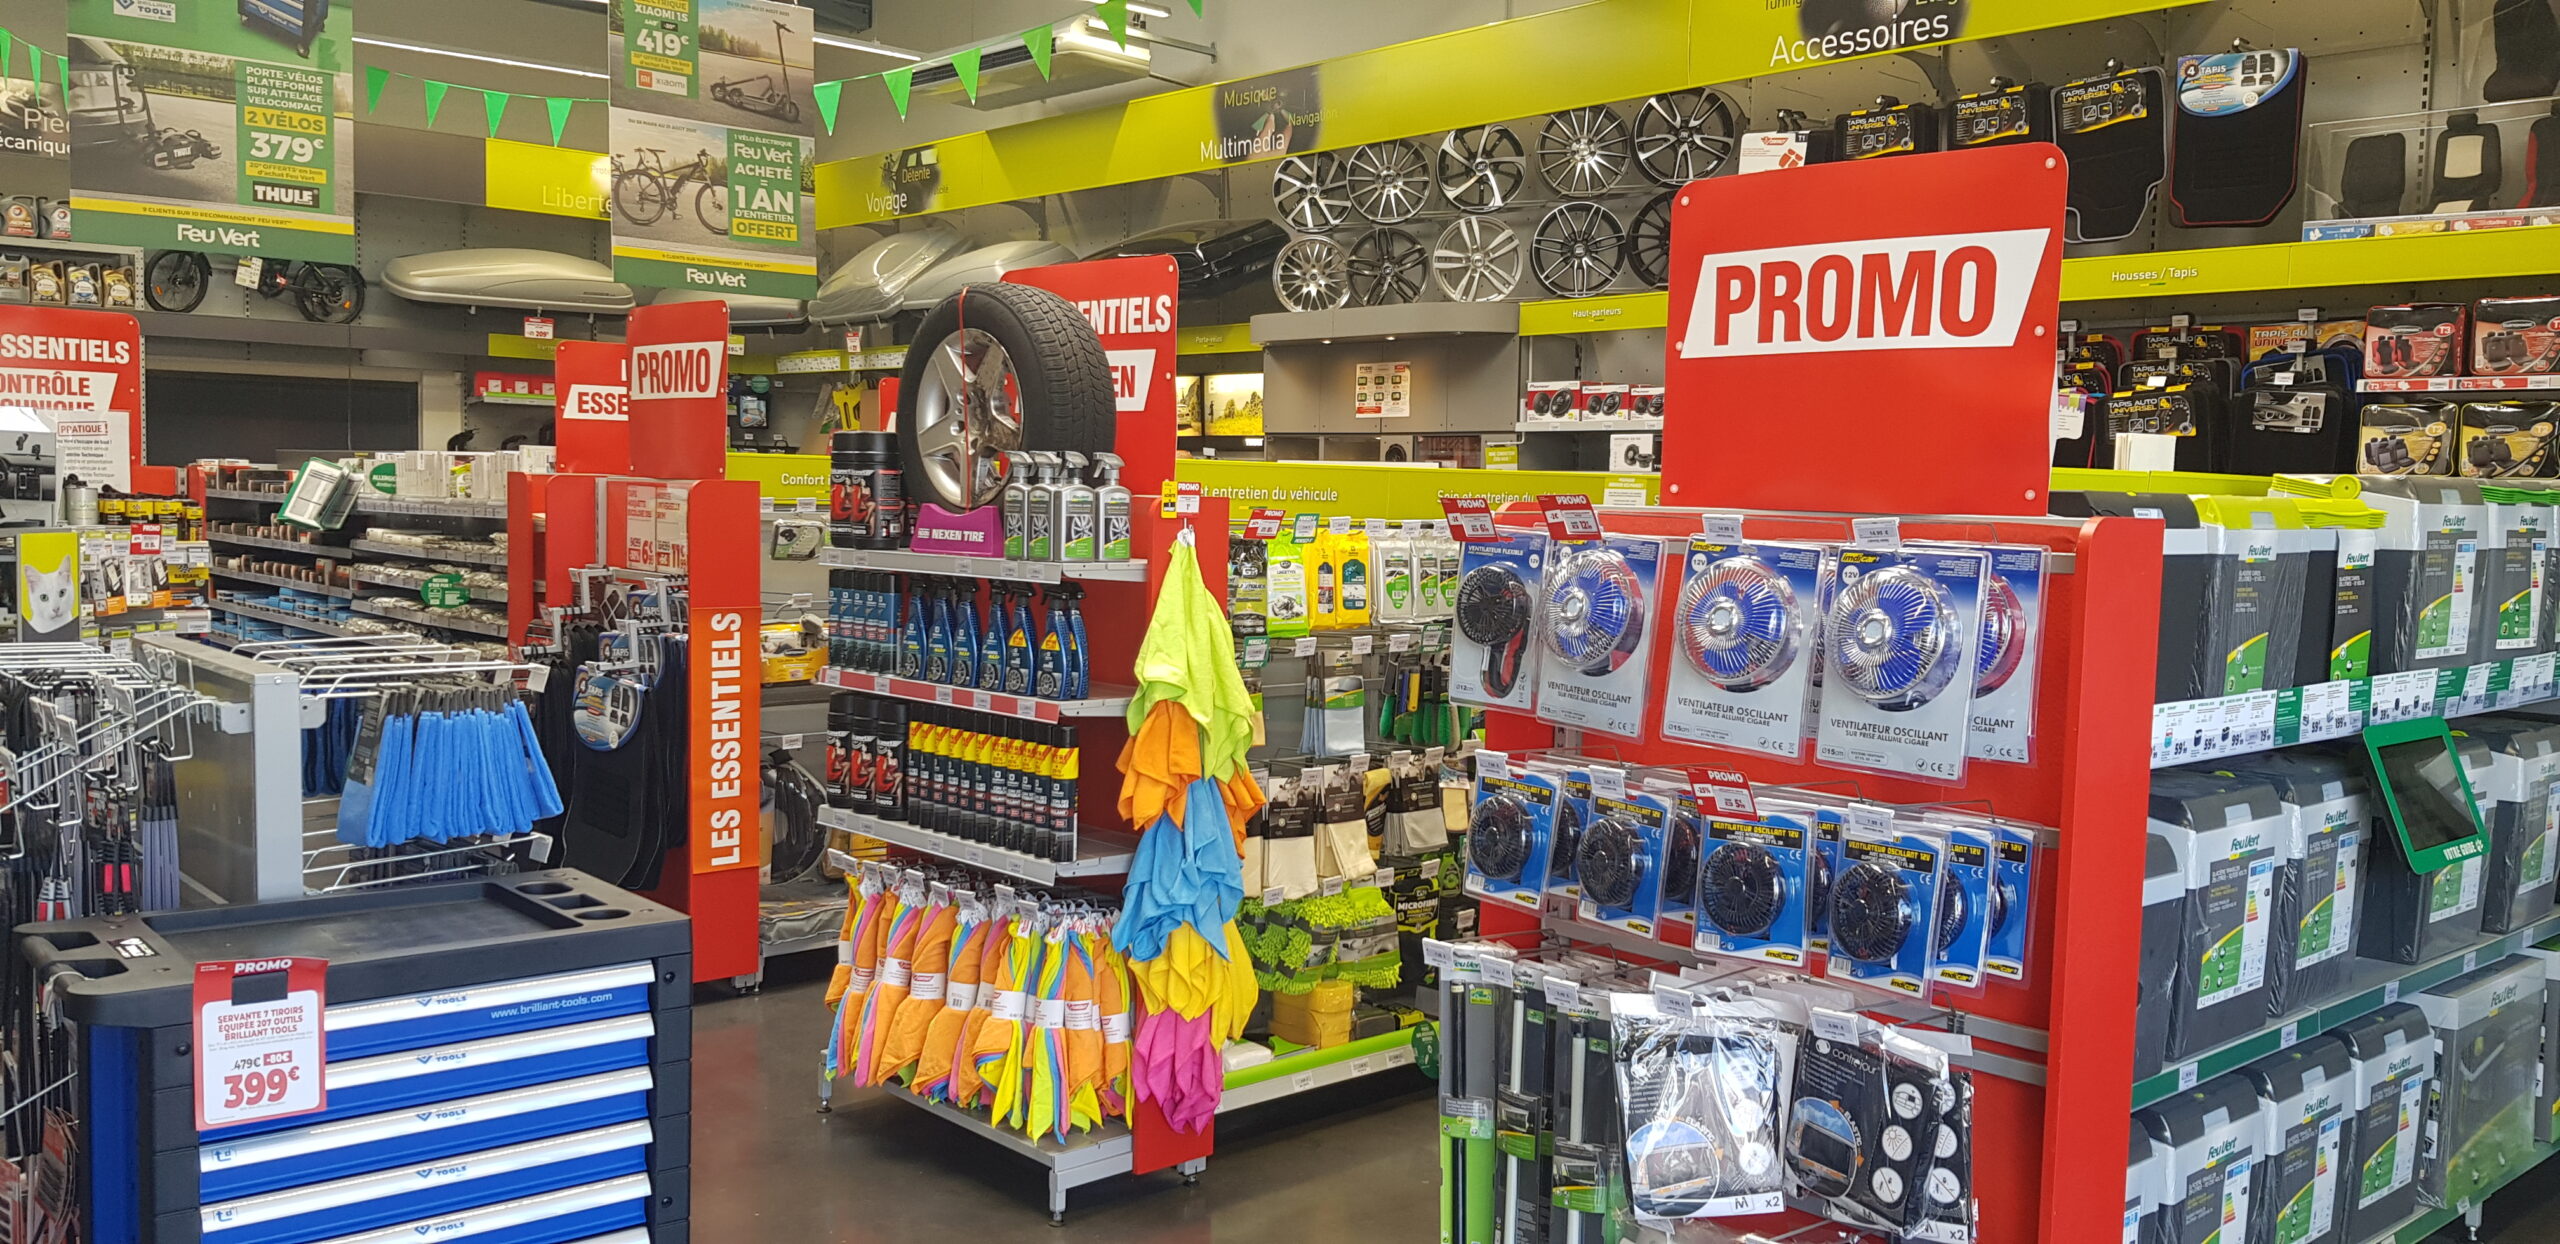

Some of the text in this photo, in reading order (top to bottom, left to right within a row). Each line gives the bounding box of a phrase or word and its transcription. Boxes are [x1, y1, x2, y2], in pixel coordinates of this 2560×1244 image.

[138, 6, 172, 16] TOOLS
[634, 4, 688, 22] XIAOMI 1S
[636, 28, 689, 57] 419€
[1770, 14, 1949, 68] Accessoires
[246, 66, 324, 84] PORTE-VÉLOS
[2187, 65, 2226, 75] 4 TAPIS
[246, 76, 322, 94] PLATEFORME
[656, 78, 685, 89] xiaomi
[2062, 83, 2110, 99] TAPIS AUTO
[247, 86, 323, 103] SUR ATTELAGE
[1224, 86, 1276, 108] Musique
[2064, 90, 2110, 103] UNIVERSEL
[1956, 99, 1999, 111] TAPIS AUTO
[1958, 105, 1999, 115] UNIVERSEL
[248, 111, 324, 132] 2 VÉLOS
[1288, 108, 1338, 127] Navigation
[250, 131, 324, 163] 379€
[756, 136, 792, 147] ÉLECTRIQUE
[1200, 129, 1285, 162] Multimédia
[734, 142, 792, 164] Feu Vert
[735, 162, 792, 180] ACHETÉ
[902, 168, 931, 184] Détente
[254, 184, 313, 206] THULE
[735, 185, 794, 214] 1 AN
[866, 192, 908, 216] Voyage
[148, 207, 176, 215] CLIENTS
[200, 212, 255, 222] RECOMMANDENT
[735, 209, 794, 223] D'ENTRETIEN
[177, 223, 260, 248] Feu Vert
[736, 222, 794, 238] OFFERT
[686, 268, 746, 288] Feu Vert
[2112, 268, 2158, 282] Housses
[2169, 265, 2198, 280] Tapis
[1714, 245, 1997, 347] PROMO
[1071, 294, 1172, 334] ENTIELS
[1572, 306, 1622, 318] Haut-parleurs
[2255, 328, 2322, 338] TAPIS AUO
[2438, 326, 2452, 334] T3
[0, 334, 130, 364] SSENTIELS
[637, 348, 711, 394] PROMO
[578, 392, 628, 415] ESSE
[2110, 404, 2158, 414] UNIVERSEL
[2134, 398, 2157, 406] AUTO
[2430, 425, 2443, 434] T2
[2535, 425, 2549, 433] T2
[782, 473, 824, 486] Confort
[1178, 483, 1199, 491] PROMO
[1213, 488, 1268, 499] entretien
[1272, 486, 1286, 500] du
[1290, 486, 1338, 501] véhicule
[1522, 492, 1534, 502] du
[1556, 496, 1586, 505] PROMO
[1458, 500, 1485, 508] PROMO
[2442, 515, 2466, 527] Feu Vert
[931, 530, 984, 542] NEXEN TIRE
[1468, 546, 1501, 554] VENTILATEUR
[612, 648, 629, 656] TAPIS
[588, 685, 603, 696] TAPIS
[1547, 681, 1632, 704] VENTILATEUR OSCILLANT
[1678, 696, 1789, 722] VENTILATEUR OSCILLANT
[1704, 710, 1720, 719] PRISE
[1721, 713, 1745, 722] ALLUME
[1746, 717, 1770, 726] CIGARE
[1973, 716, 2015, 728] CILLANT
[1831, 718, 1949, 743] VENTILATEUR OSCILLANT
[711, 612, 742, 866] LES ESSENTIELS
[1859, 732, 1875, 740] PRISE
[1877, 734, 1902, 744] ALLUME
[1904, 738, 1928, 747] CIGARE
[1708, 771, 1743, 783] PROMO
[1713, 822, 1753, 832] VENTILATEUR
[1754, 827, 1787, 836] OSCILLANT
[1848, 841, 1931, 861] VENTILATEUR OSCILLANT 12V
[2231, 834, 2260, 852] Feu Vert
[2443, 842, 2476, 861] VOTRE GUIDE
[234, 959, 292, 974] PROMO
[436, 996, 467, 1005] TOOLS
[490, 992, 613, 1019] www.brilliant-tools.com
[218, 1011, 261, 1024] SERVANTE
[271, 1006, 303, 1017] TIROIRS
[257, 1019, 272, 1028] 207
[274, 1015, 303, 1025] OUTILS
[224, 1025, 298, 1041] BRILLIANT TOOLS
[234, 1053, 290, 1070] 479€ -80€
[435, 1053, 467, 1063] TOOLS
[224, 1066, 300, 1109] 399€
[435, 1109, 467, 1119] TOOLS
[2208, 1136, 2238, 1160] Feu Vert
[435, 1166, 467, 1176] TOOLS
[1734, 1195, 1781, 1210] M x2
[434, 1222, 465, 1232] TOOLS
